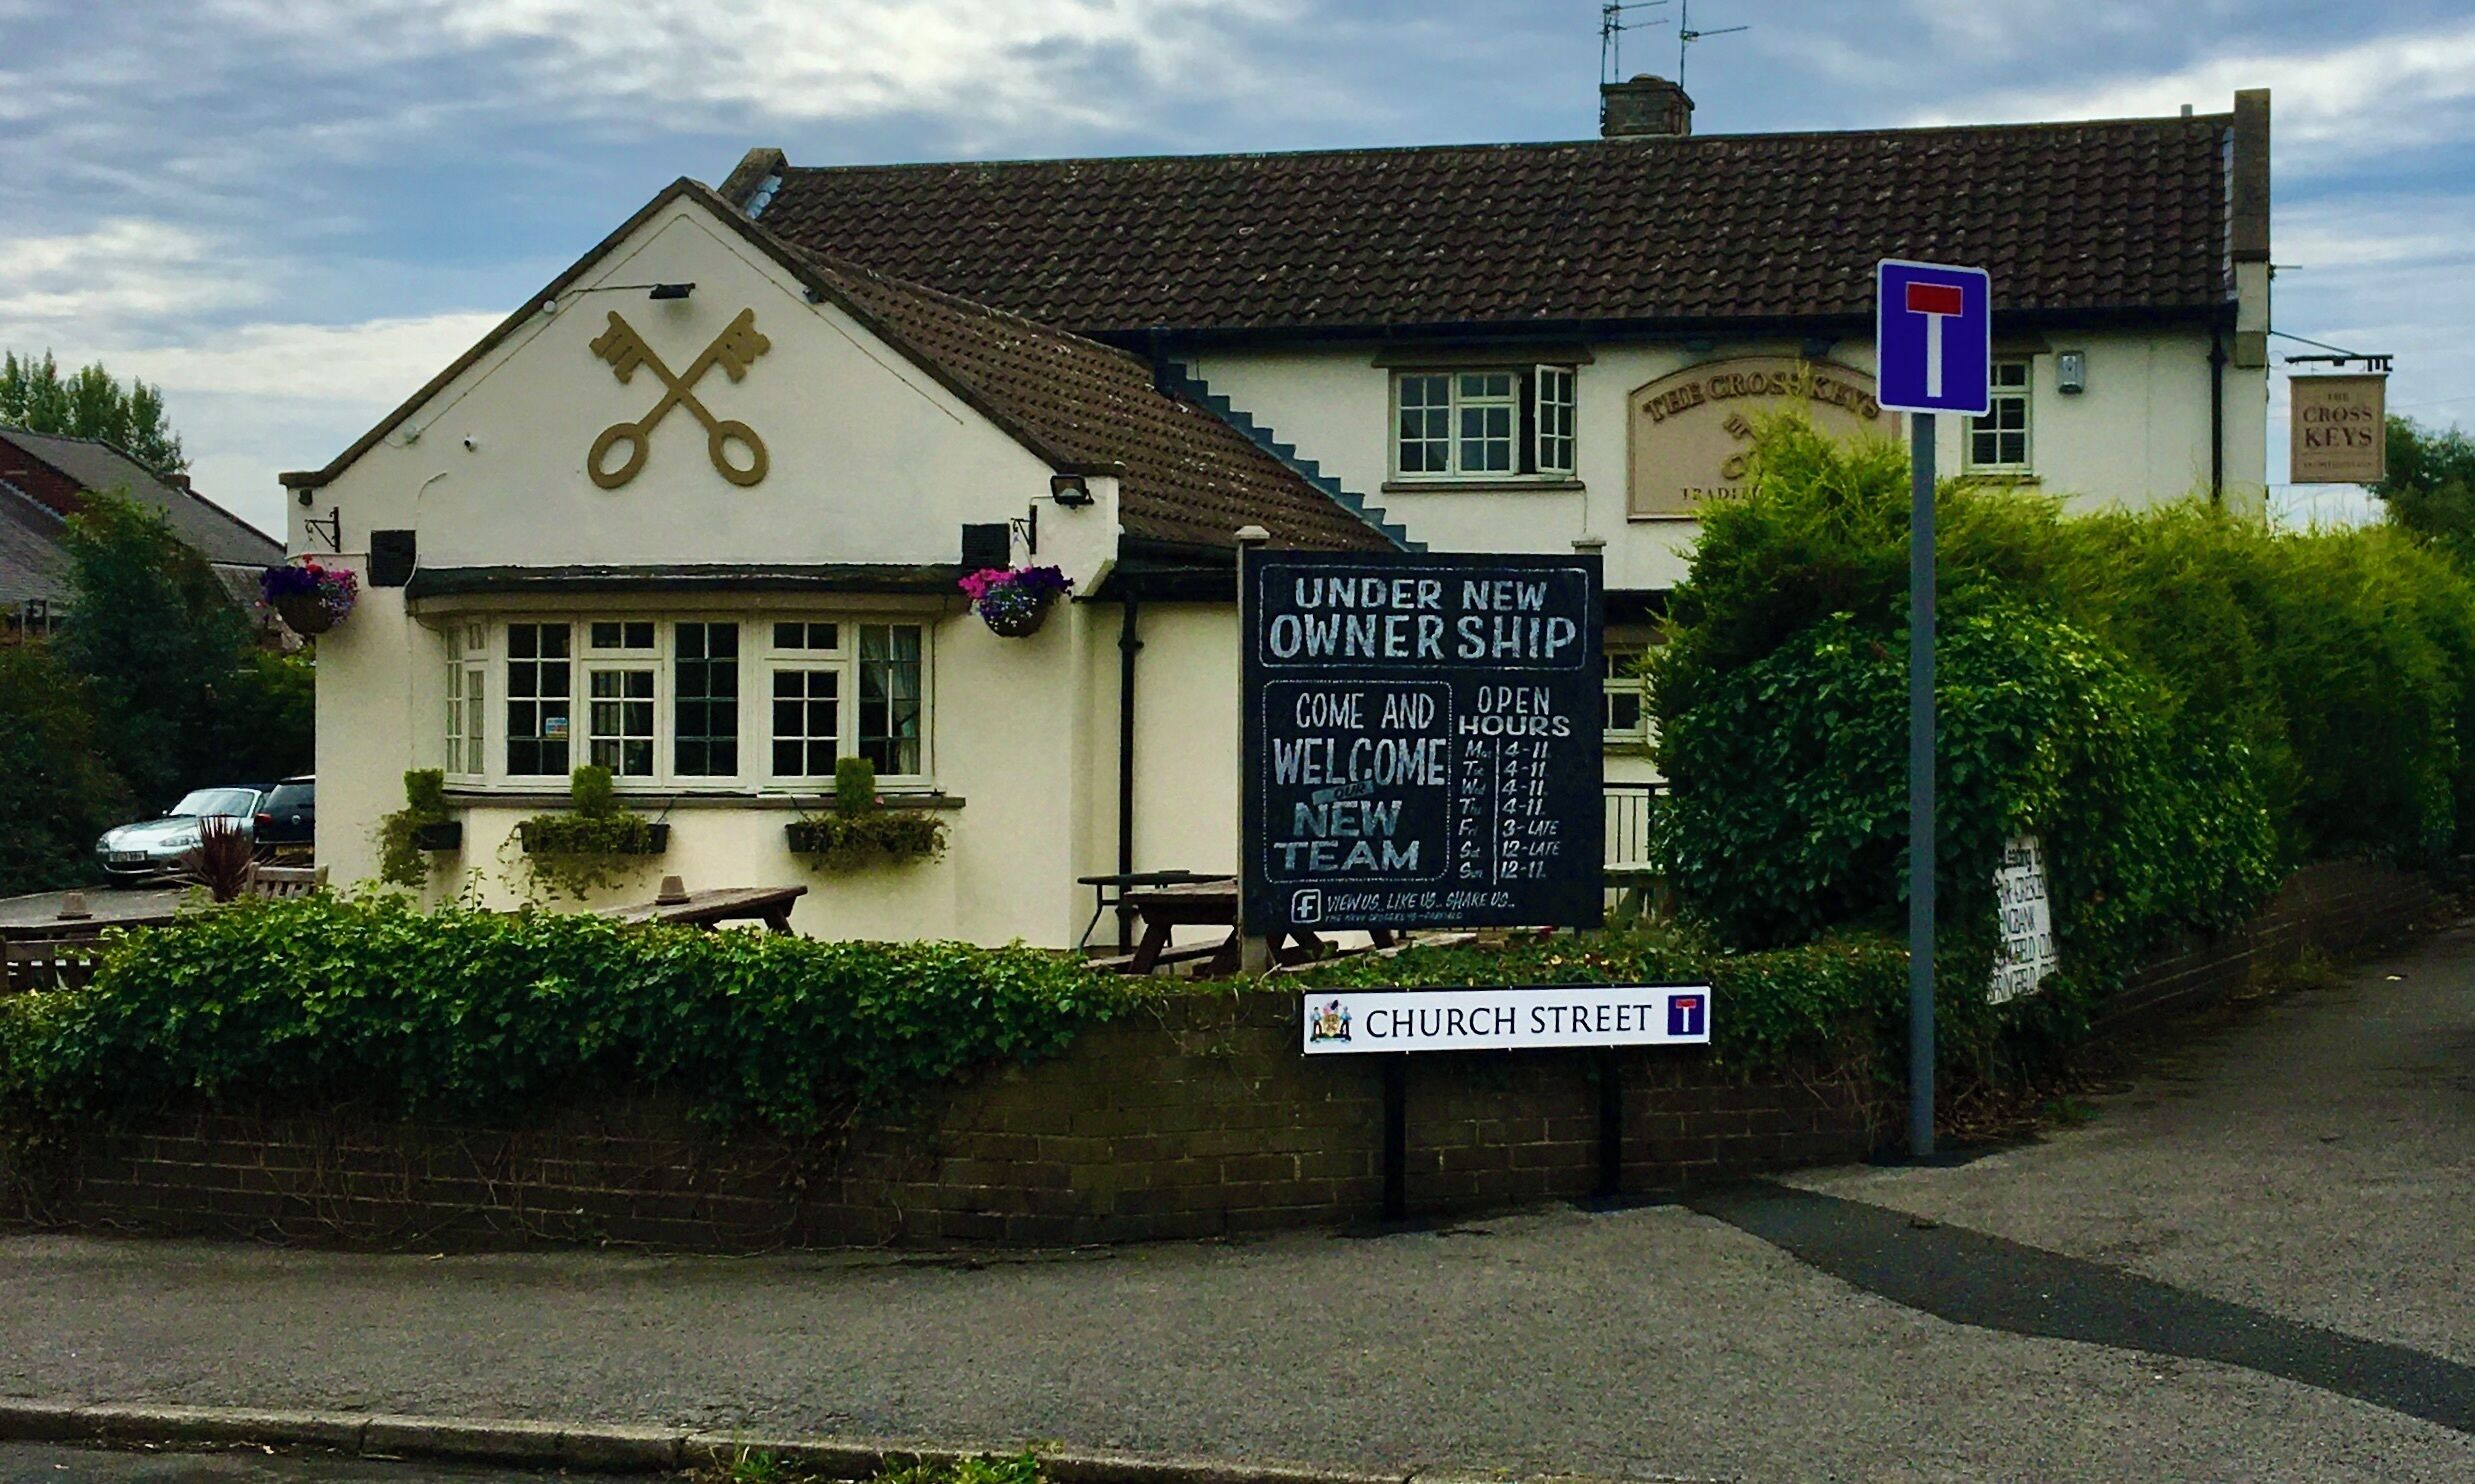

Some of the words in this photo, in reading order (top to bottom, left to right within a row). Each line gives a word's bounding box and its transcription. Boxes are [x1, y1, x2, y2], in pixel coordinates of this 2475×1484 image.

[1642, 382, 1705, 423] THE
[1705, 371, 1801, 400] CROSS
[1809, 375, 1880, 419] KEYS
[2303, 406, 2373, 423] CROSS
[2305, 426, 2373, 448] KEYS
[1296, 577, 1442, 610] UNDER
[1462, 580, 1547, 612] NEW
[1269, 613, 1576, 660] OWNERSHIP
[1296, 692, 1364, 729] COME
[1381, 693, 1435, 729] AND
[1478, 685, 1550, 716] OPEN
[1458, 715, 1571, 737] HOURS
[1273, 737, 1446, 787] WELCOME
[1334, 781, 1367, 801] OUR
[1293, 800, 1402, 838] NEW
[1273, 840, 1420, 871] TEAM
[1460, 840, 1480, 859] Sat
[1327, 893, 1362, 912] VIEW
[1386, 892, 1418, 910] LIKE
[1446, 890, 1488, 910] SHARE
[1366, 1007, 1516, 1038] CHURCH
[1530, 1004, 1652, 1034] STREET
